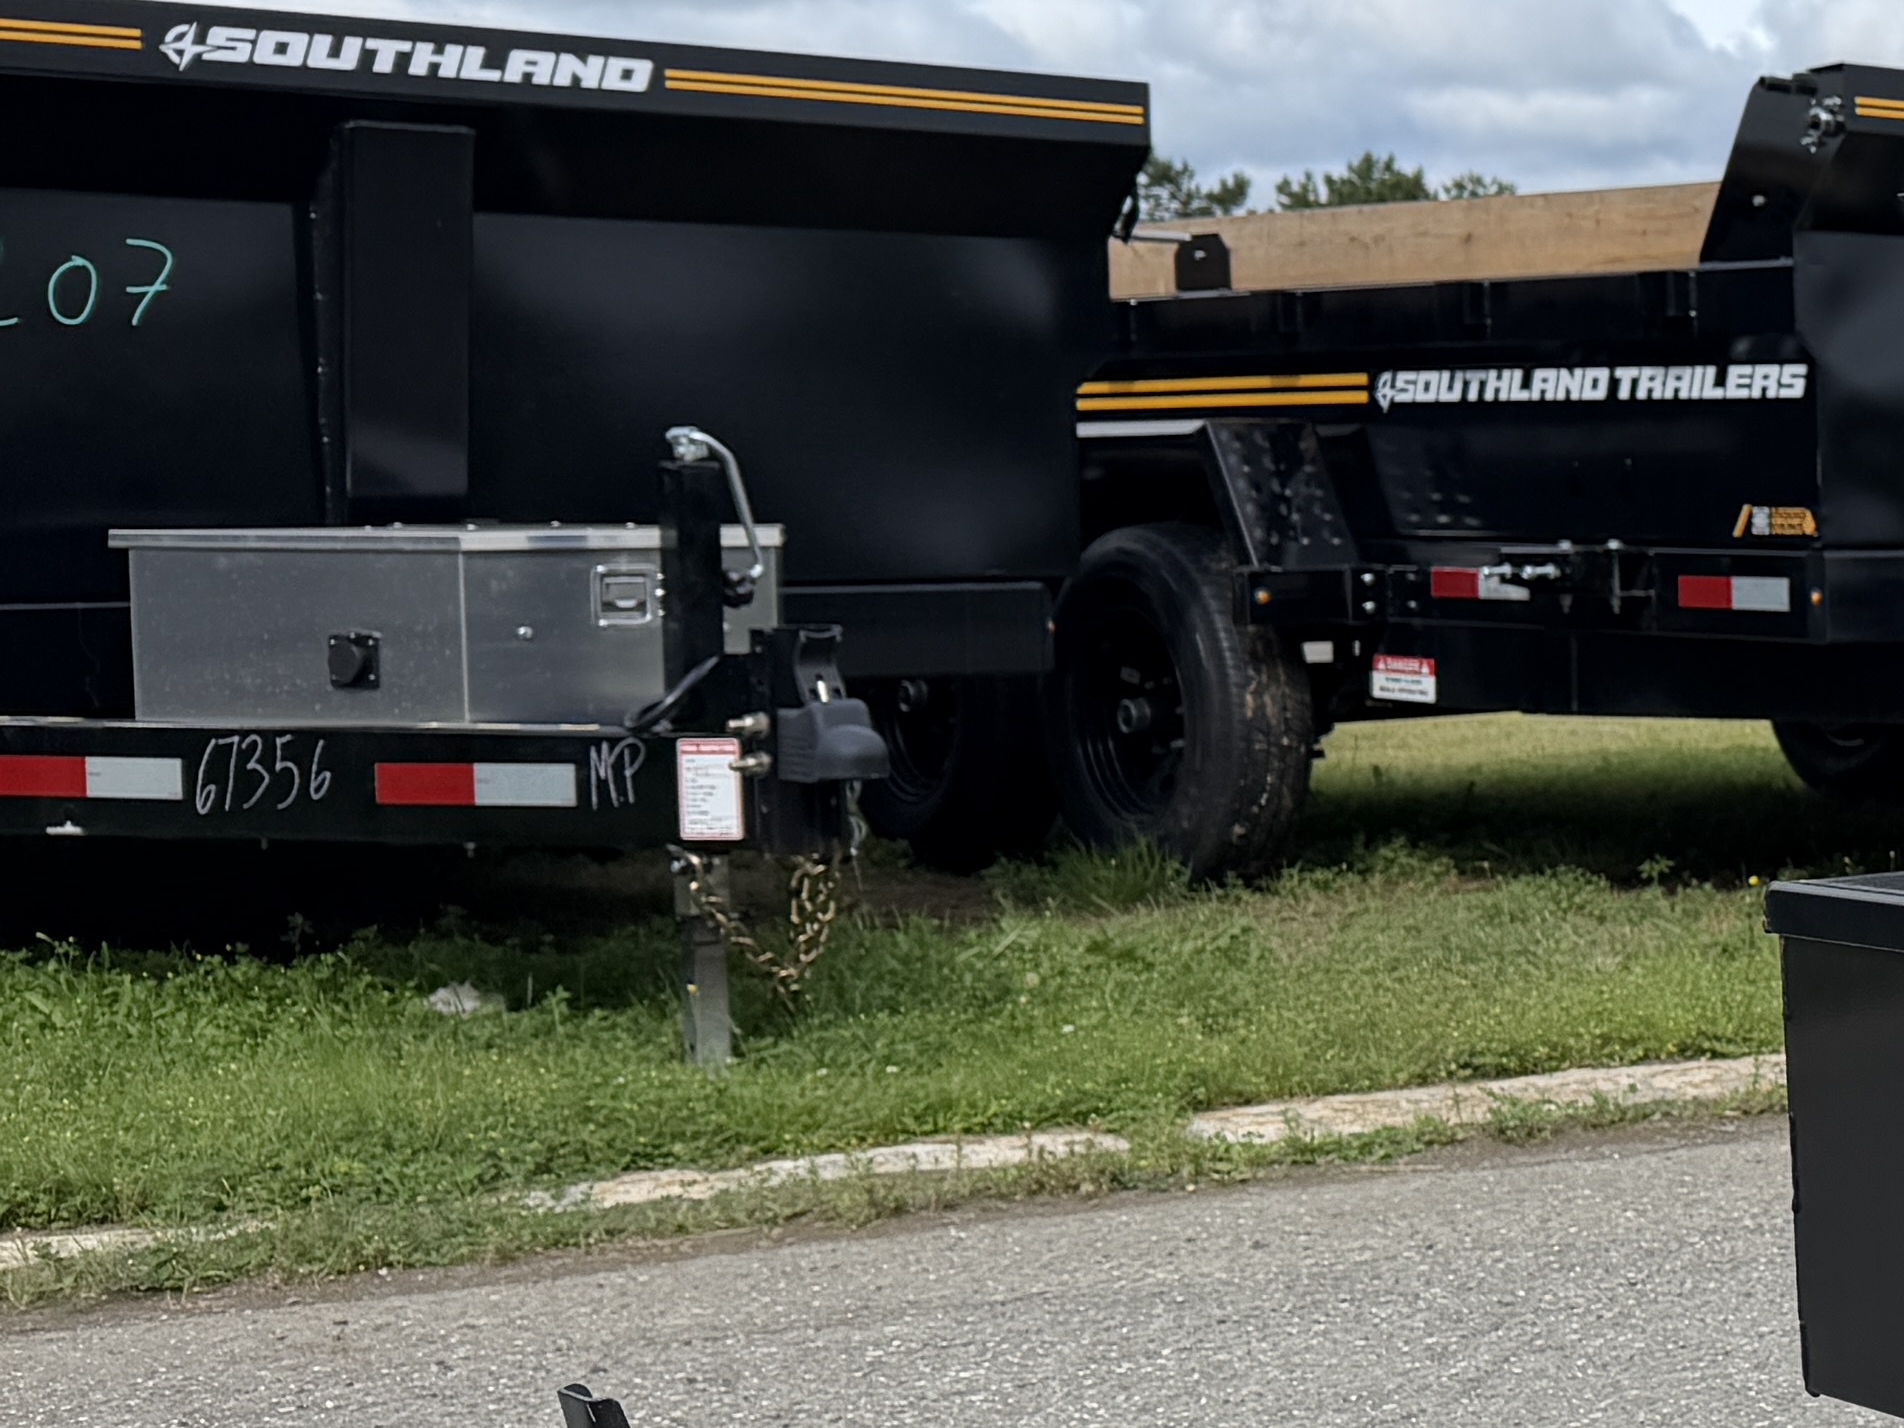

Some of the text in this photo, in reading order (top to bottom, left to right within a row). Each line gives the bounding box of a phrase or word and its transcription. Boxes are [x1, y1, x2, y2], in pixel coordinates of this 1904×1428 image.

[201, 25, 655, 93] SOUTHLAND
[1395, 363, 1808, 403] SOUTHLAND TRAILERS
[195, 734, 332, 815] 67356
